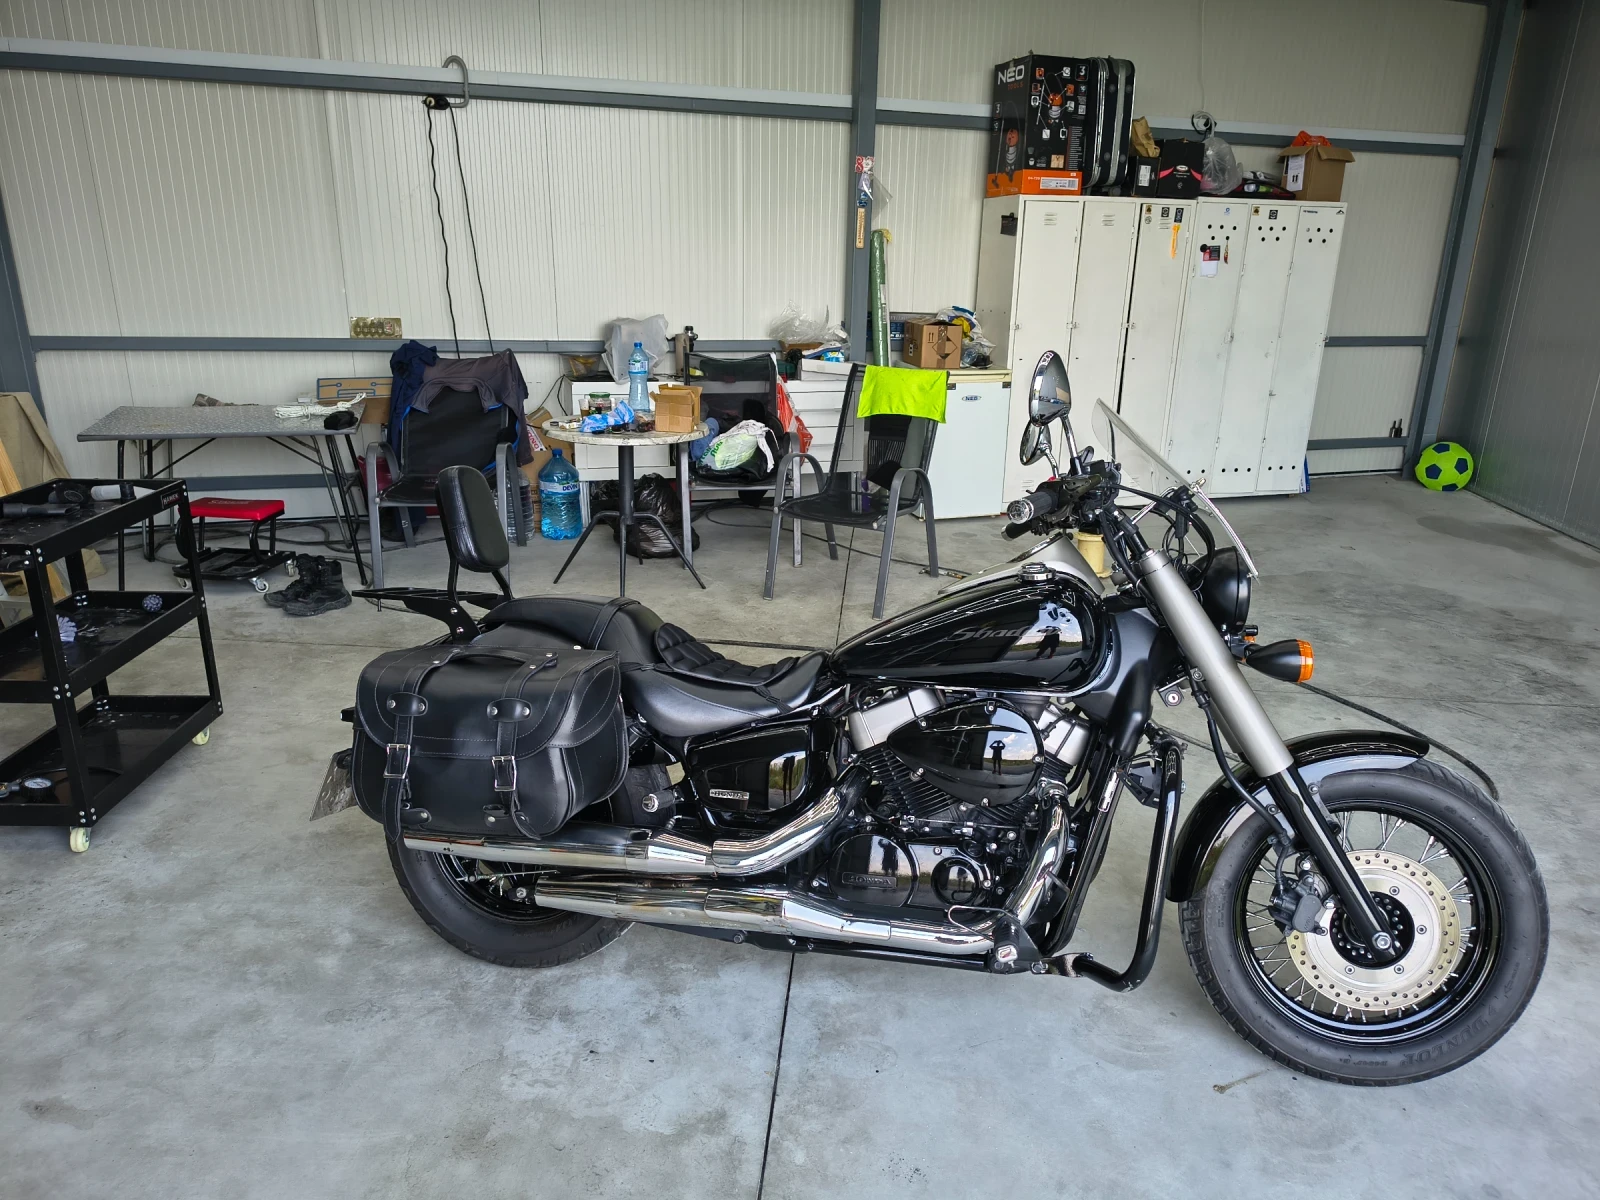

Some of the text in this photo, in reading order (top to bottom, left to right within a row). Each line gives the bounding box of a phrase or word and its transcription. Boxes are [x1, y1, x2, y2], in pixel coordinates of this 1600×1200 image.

[997, 64, 1025, 85] NEO
[1007, 82, 1024, 91] TOOLS
[1402, 1016, 1488, 1067] DUNLOP
